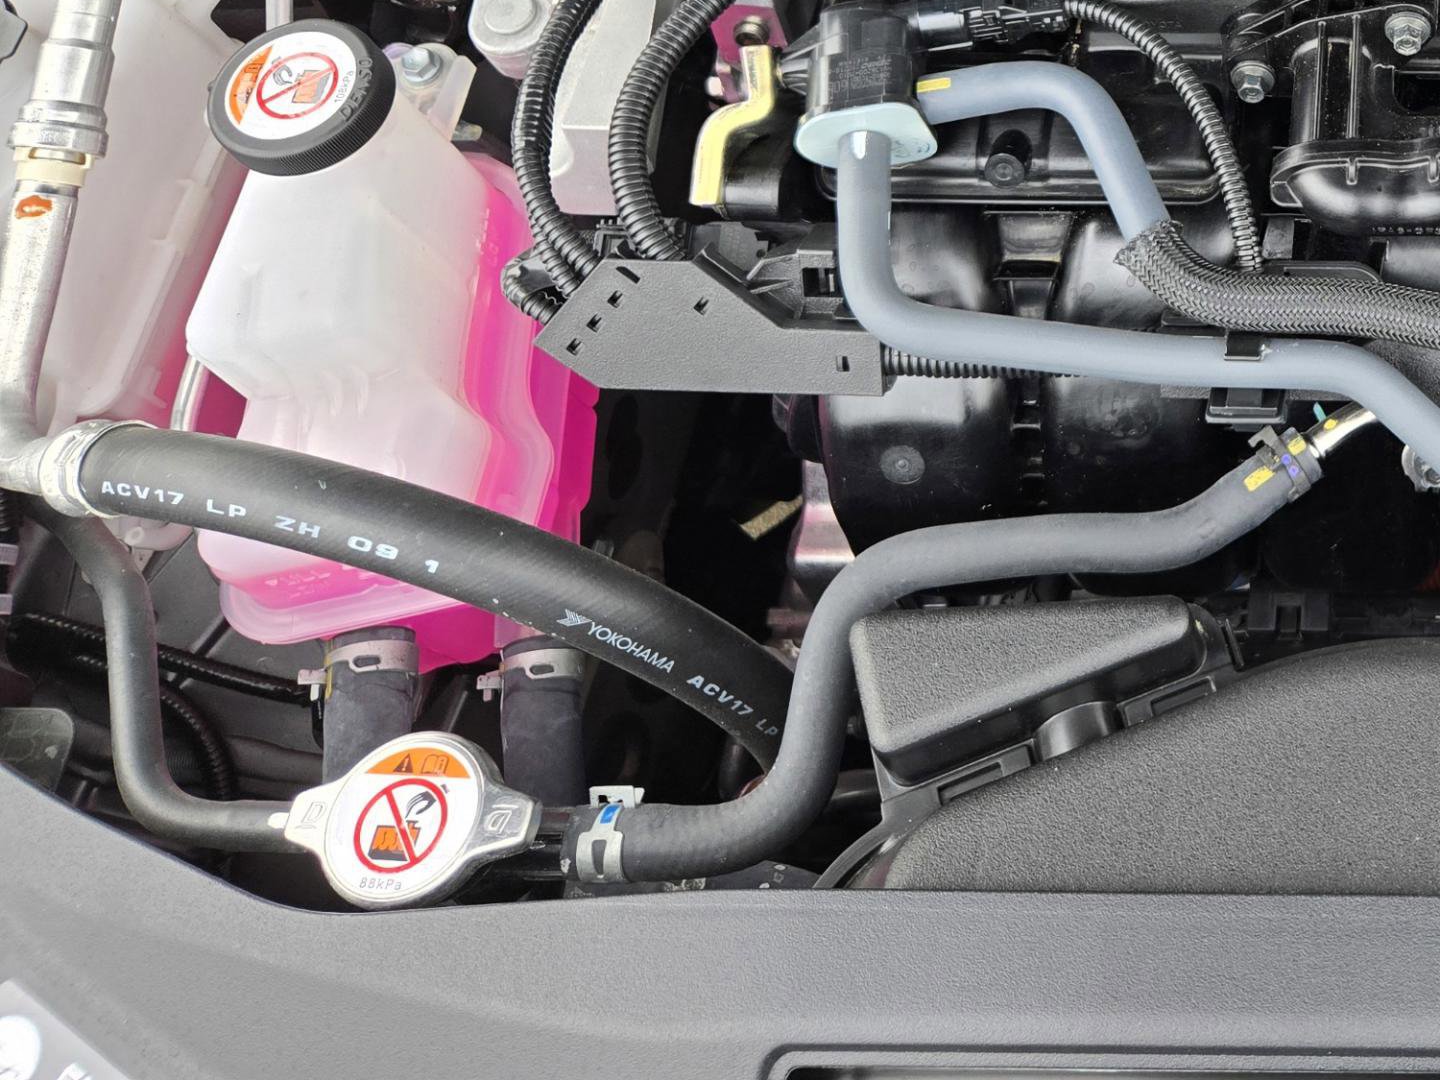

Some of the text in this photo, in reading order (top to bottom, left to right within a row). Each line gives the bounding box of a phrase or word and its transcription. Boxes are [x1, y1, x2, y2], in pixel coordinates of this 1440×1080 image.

[338, 57, 374, 122] DENSO
[101, 480, 440, 575] ACV17 LP ZH 09 1
[586, 621, 675, 674] YOKOHAMA
[686, 674, 779, 736] ACV17 LP
[358, 876, 403, 891] 88kPa
